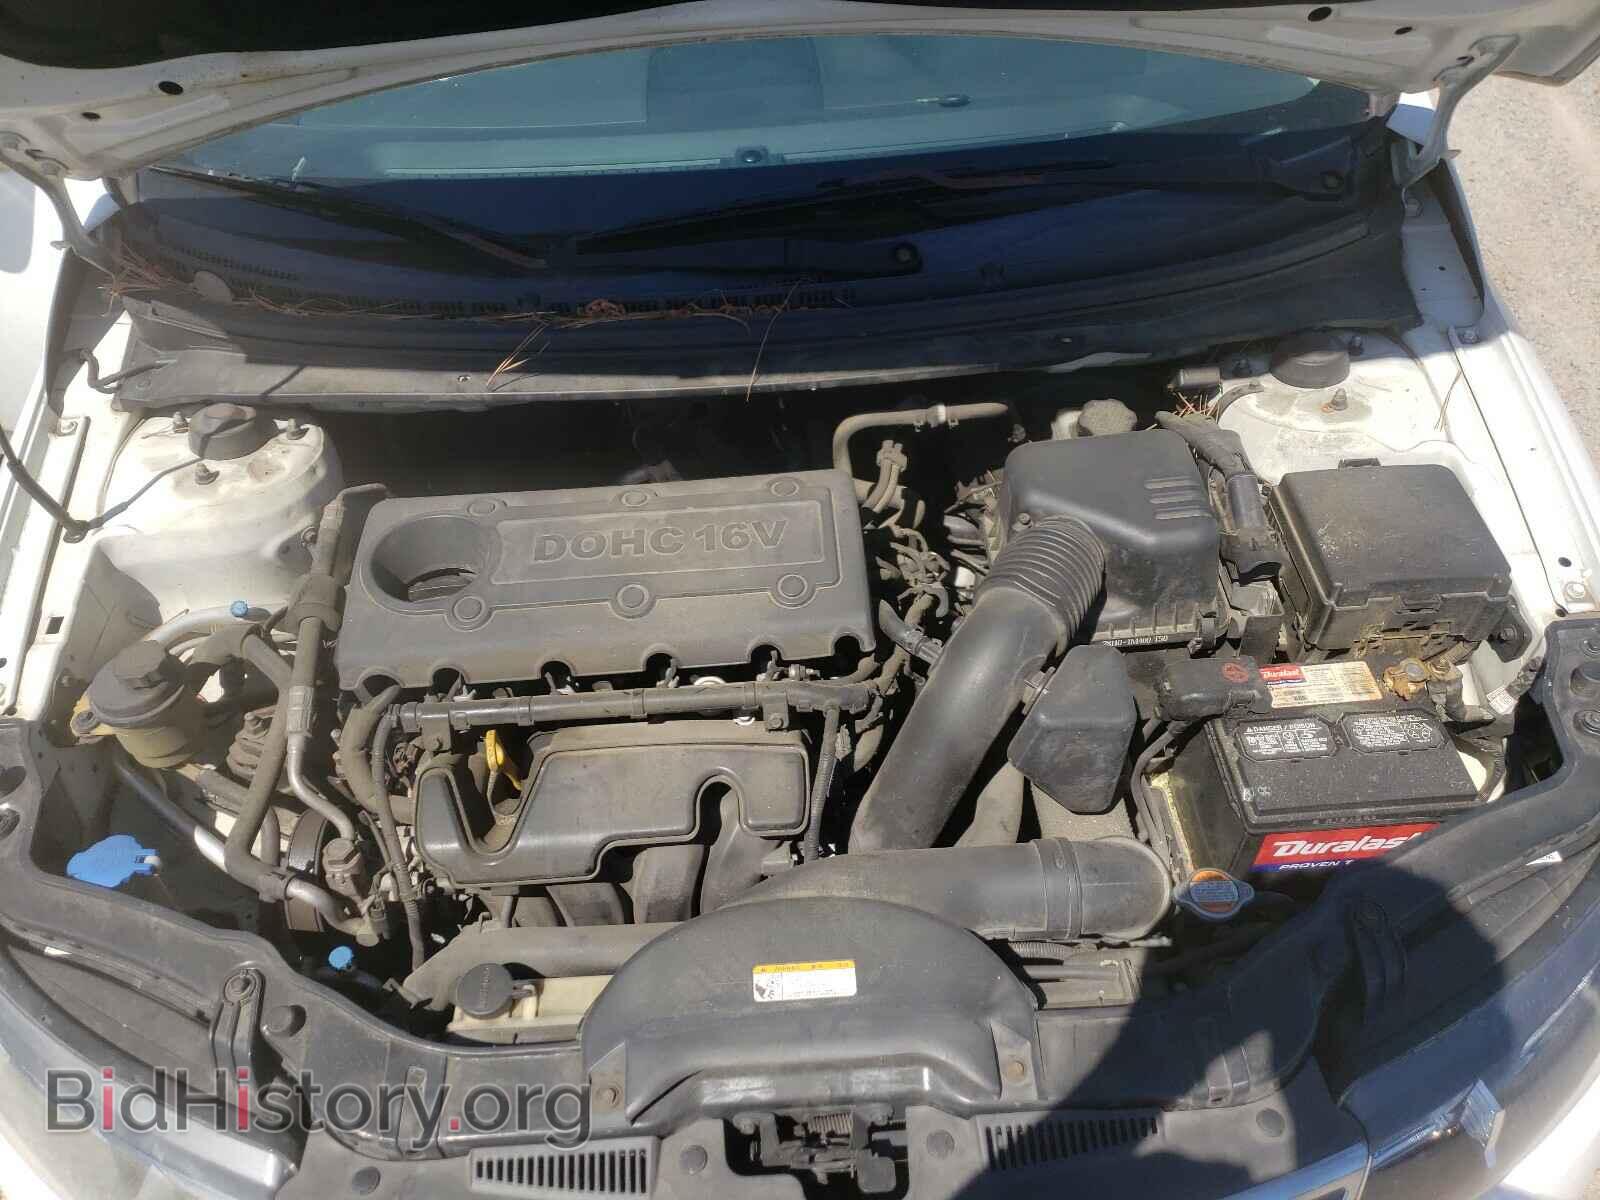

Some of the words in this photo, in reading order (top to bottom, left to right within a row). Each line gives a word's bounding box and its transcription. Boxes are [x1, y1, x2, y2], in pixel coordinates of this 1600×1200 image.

[533, 526, 685, 563] DOHC
[695, 520, 788, 552] 16V
[1263, 668, 1301, 679] Duralast
[1279, 860, 1341, 871] PROVEN
